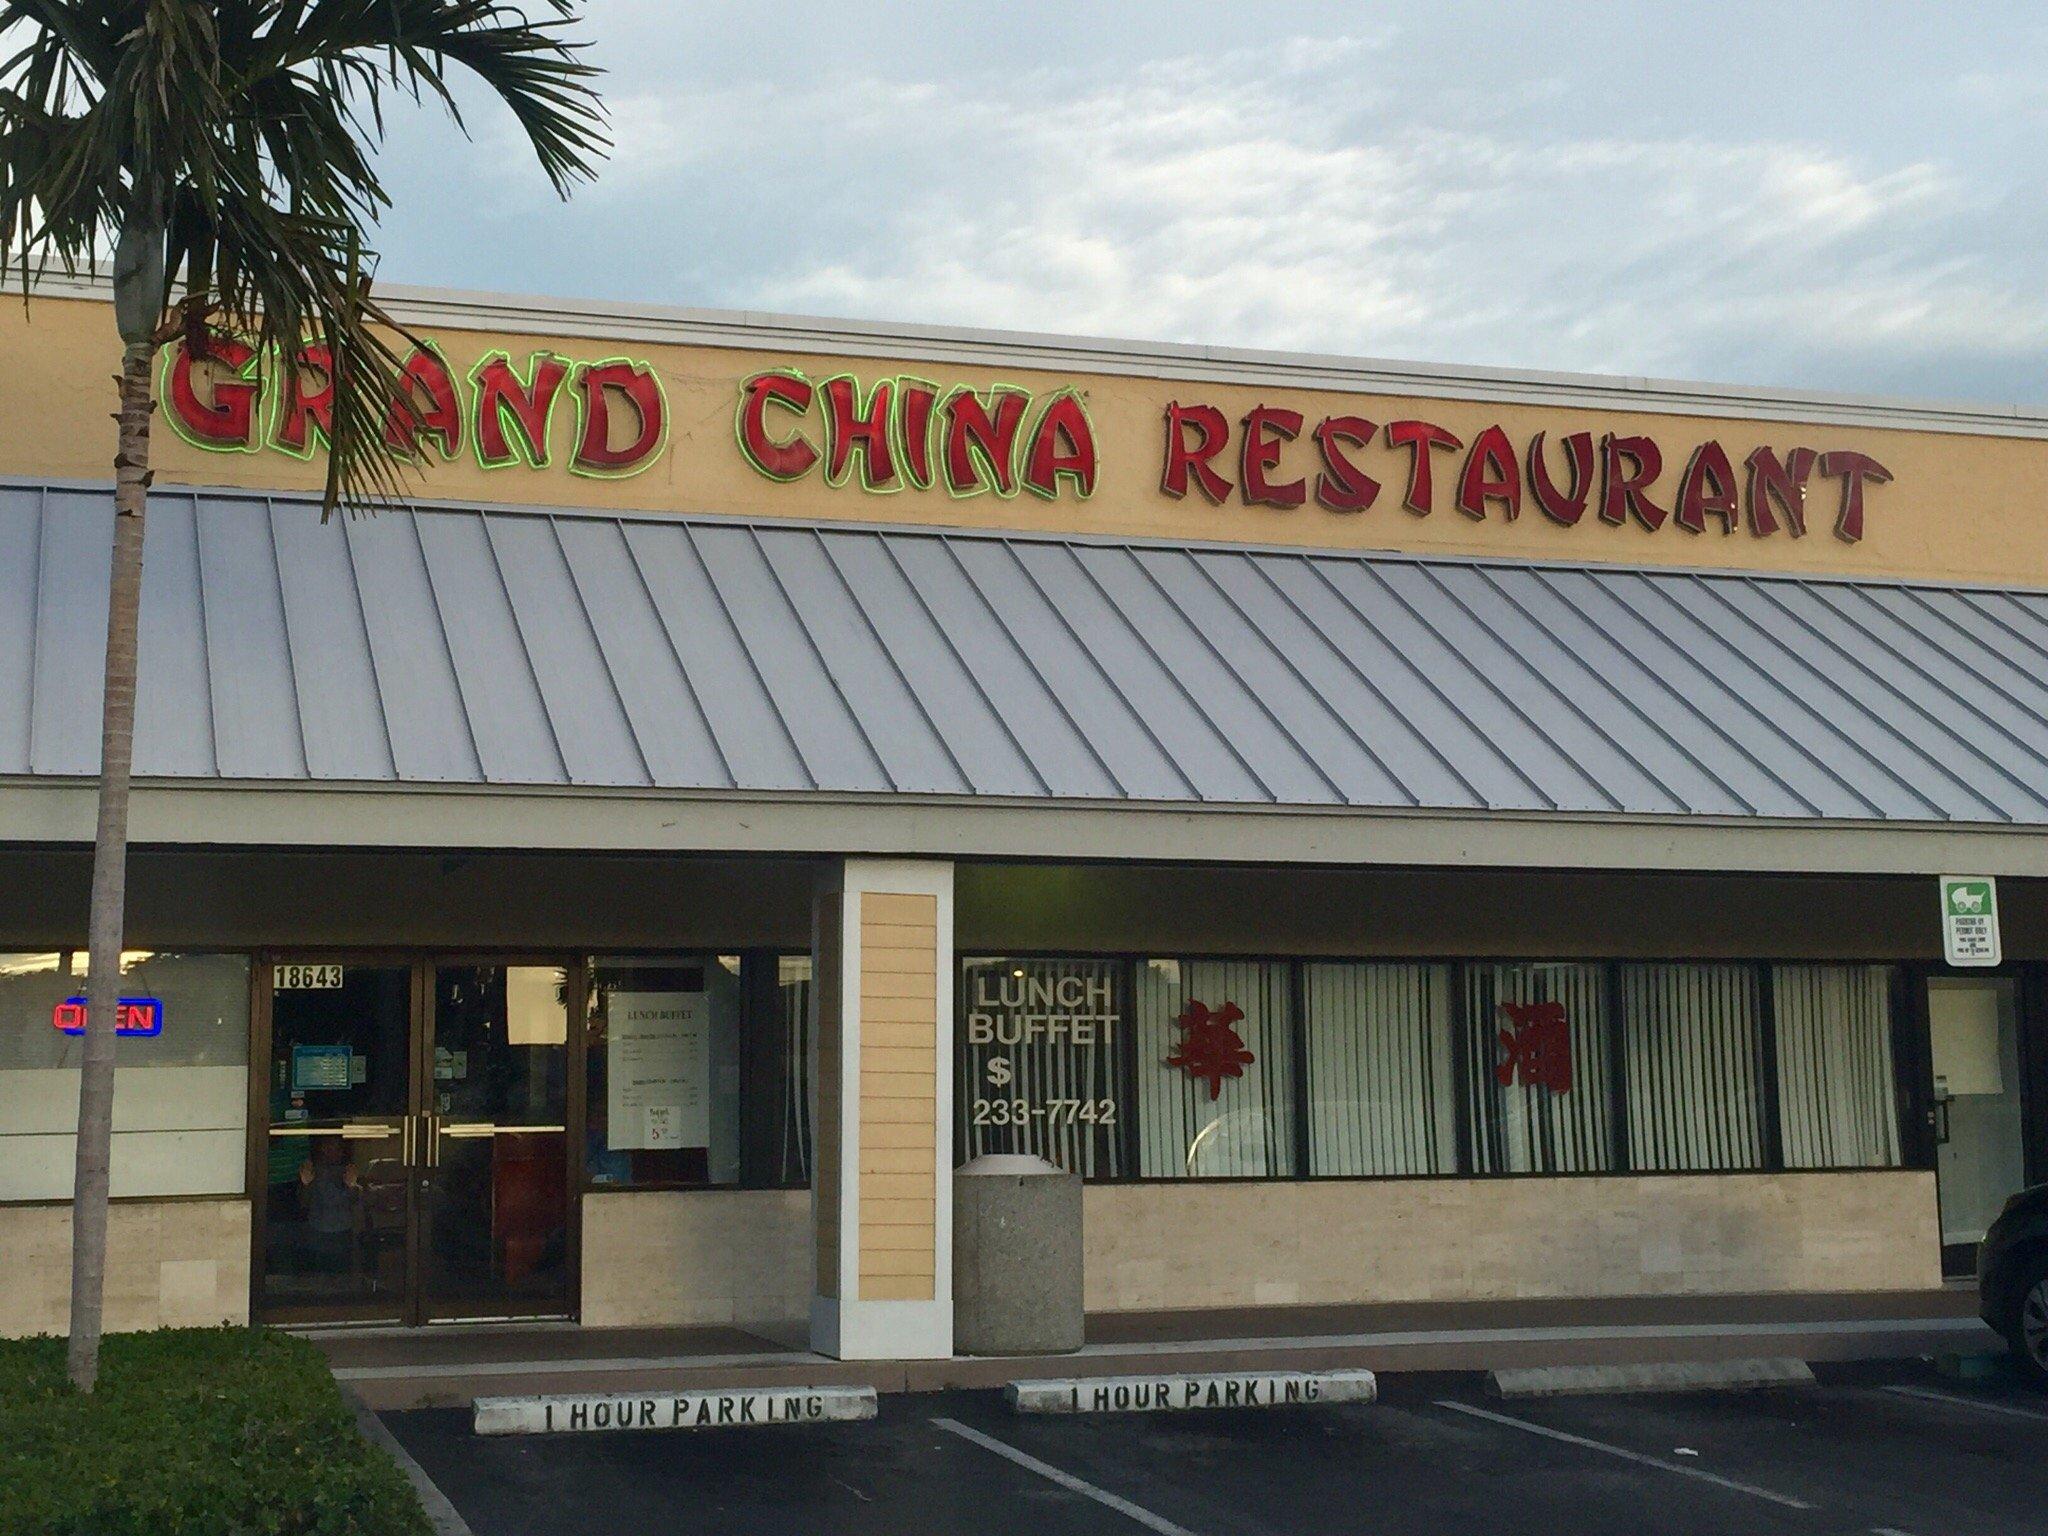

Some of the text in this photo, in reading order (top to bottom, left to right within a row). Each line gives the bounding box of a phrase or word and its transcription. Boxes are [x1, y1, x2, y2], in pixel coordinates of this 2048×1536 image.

[162, 338, 1895, 545] GRAND CHINA RESTAURANT
[276, 965, 341, 987] 18643
[978, 976, 1111, 1007] LUNCH
[53, 1004, 153, 1029] OEN
[969, 1014, 1120, 1045] BUFFET
[986, 1057, 1012, 1088] $
[973, 1098, 1117, 1126] 233-7742
[1070, 1379, 1320, 1414] 1 HOUR PARKING
[545, 1396, 824, 1431] 1 HOUR PARKING
